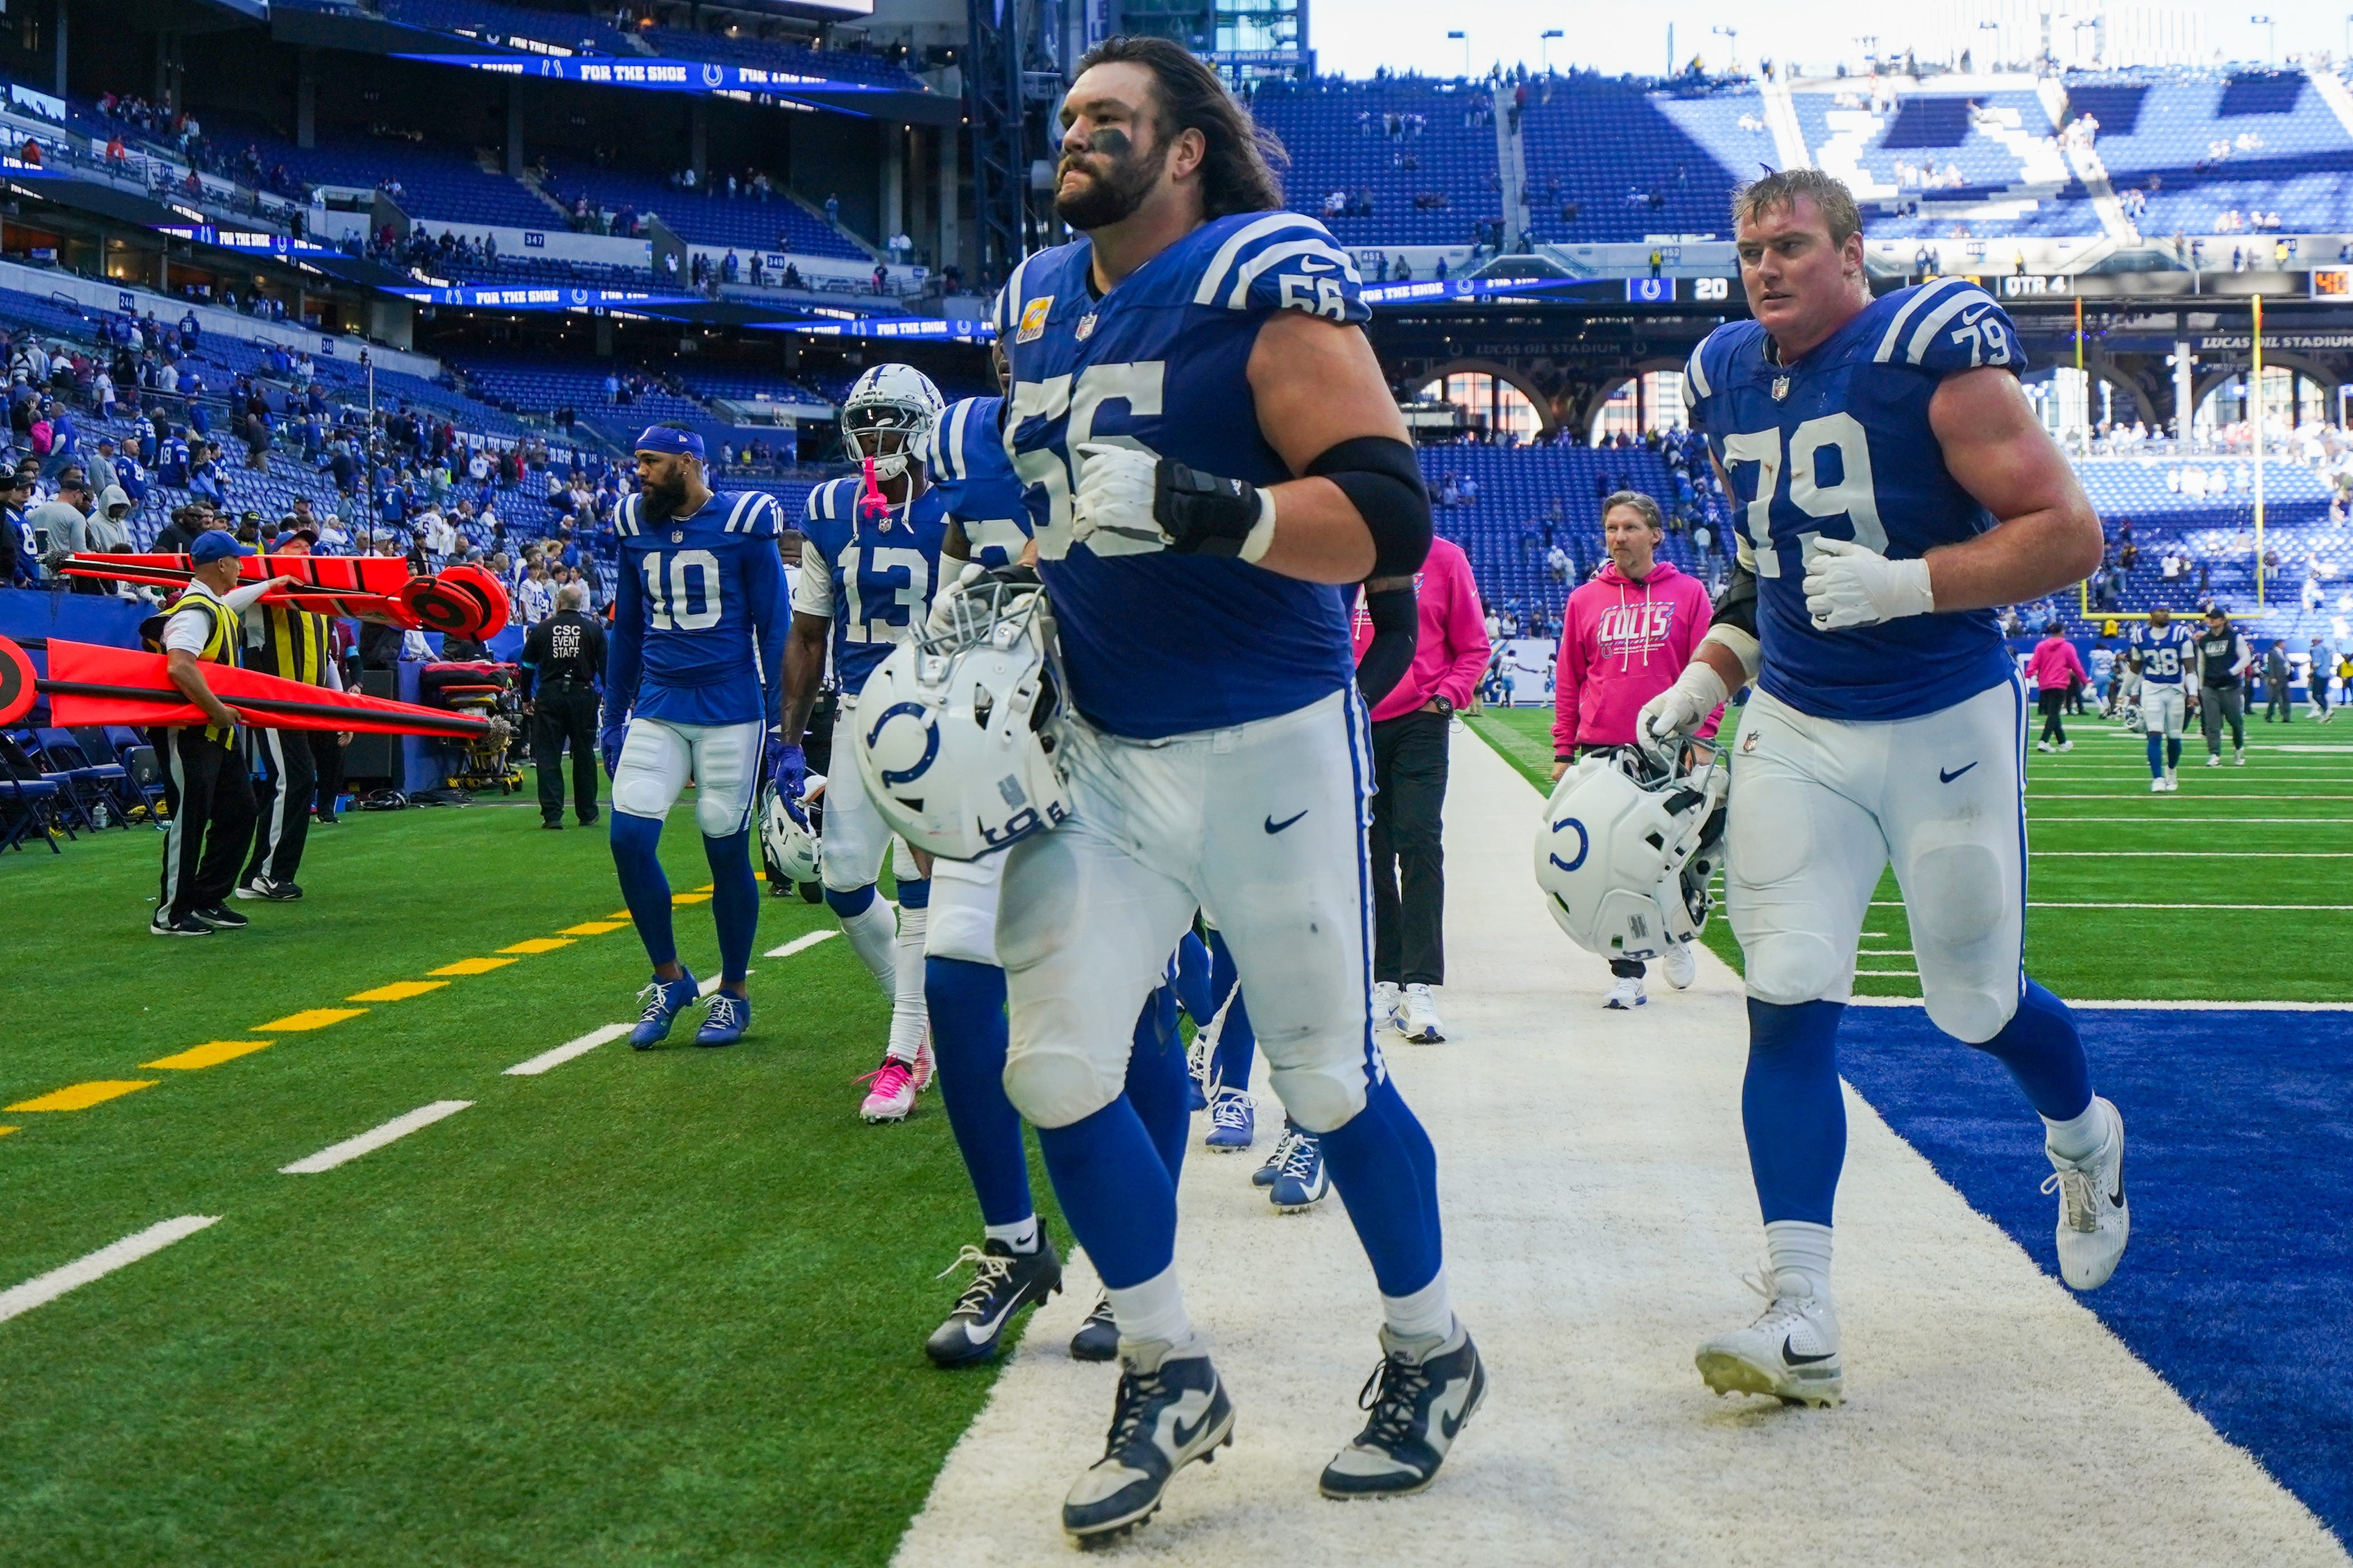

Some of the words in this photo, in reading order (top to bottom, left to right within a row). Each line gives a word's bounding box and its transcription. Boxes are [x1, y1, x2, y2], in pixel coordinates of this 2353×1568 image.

[581, 65, 611, 80] FOR
[614, 65, 645, 81] THE
[647, 66, 686, 81] SHOE
[219, 232, 234, 245] FOR
[235, 232, 250, 246] THE
[250, 233, 270, 247] SHOE
[526, 235, 542, 245] 347
[768, 257, 783, 266] 349
[1695, 278, 1728, 300] 20
[2006, 276, 2047, 297] QTR
[2050, 276, 2067, 293] 4
[2316, 271, 2347, 294] 40
[476, 292, 500, 305] FOR
[501, 291, 526, 304] THE
[527, 290, 558, 302] SHOE
[1360, 289, 1384, 302] FOR
[1384, 286, 1410, 300] THE
[1411, 282, 1444, 296] SHOE
[121, 296, 133, 308] 244
[876, 323, 897, 336] FOR
[899, 322, 920, 335] THE
[921, 321, 947, 333] SHOE
[322, 340, 333, 352] 245
[1475, 344, 1520, 355] LUCAS
[1552, 344, 1621, 354] STADIUM
[1951, 317, 2011, 367] 79
[2202, 337, 2250, 349] LUCAS
[2282, 336, 2353, 348] STADIUM
[160, 446, 172, 465] 18
[1724, 412, 1890, 578] 79
[770, 506, 783, 534] 10
[642, 549, 722, 630] 10
[837, 546, 929, 644] 13
[552, 625, 581, 635] CSC
[1601, 606, 1670, 642] COLTS
[552, 636, 580, 647] EVENT
[553, 647, 580, 658] STAFF
[2142, 648, 2178, 676] 38
